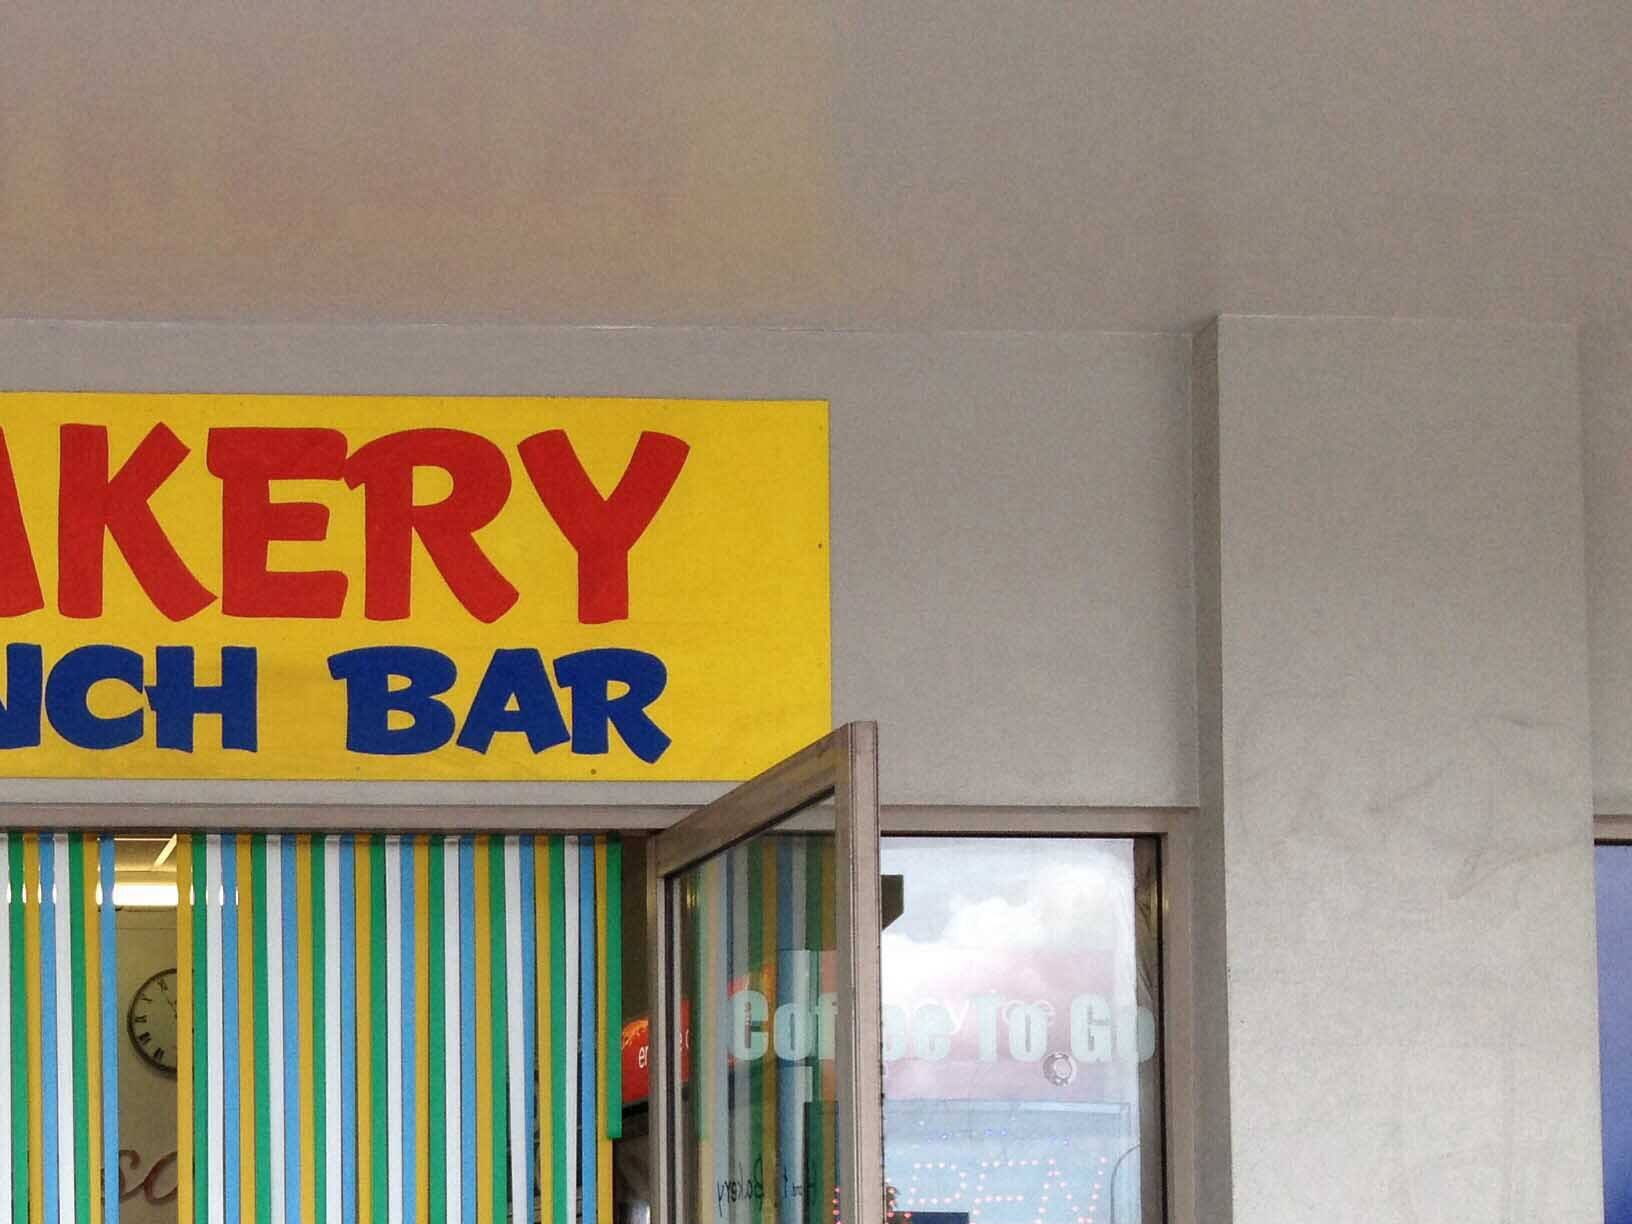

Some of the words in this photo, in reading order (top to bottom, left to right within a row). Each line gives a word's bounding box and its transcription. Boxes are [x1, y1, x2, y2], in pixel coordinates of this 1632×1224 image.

[329, 645, 671, 763] BAR
[732, 990, 954, 1062] Cofee
[968, 993, 1048, 1062] To
[1069, 993, 1156, 1062] Go
